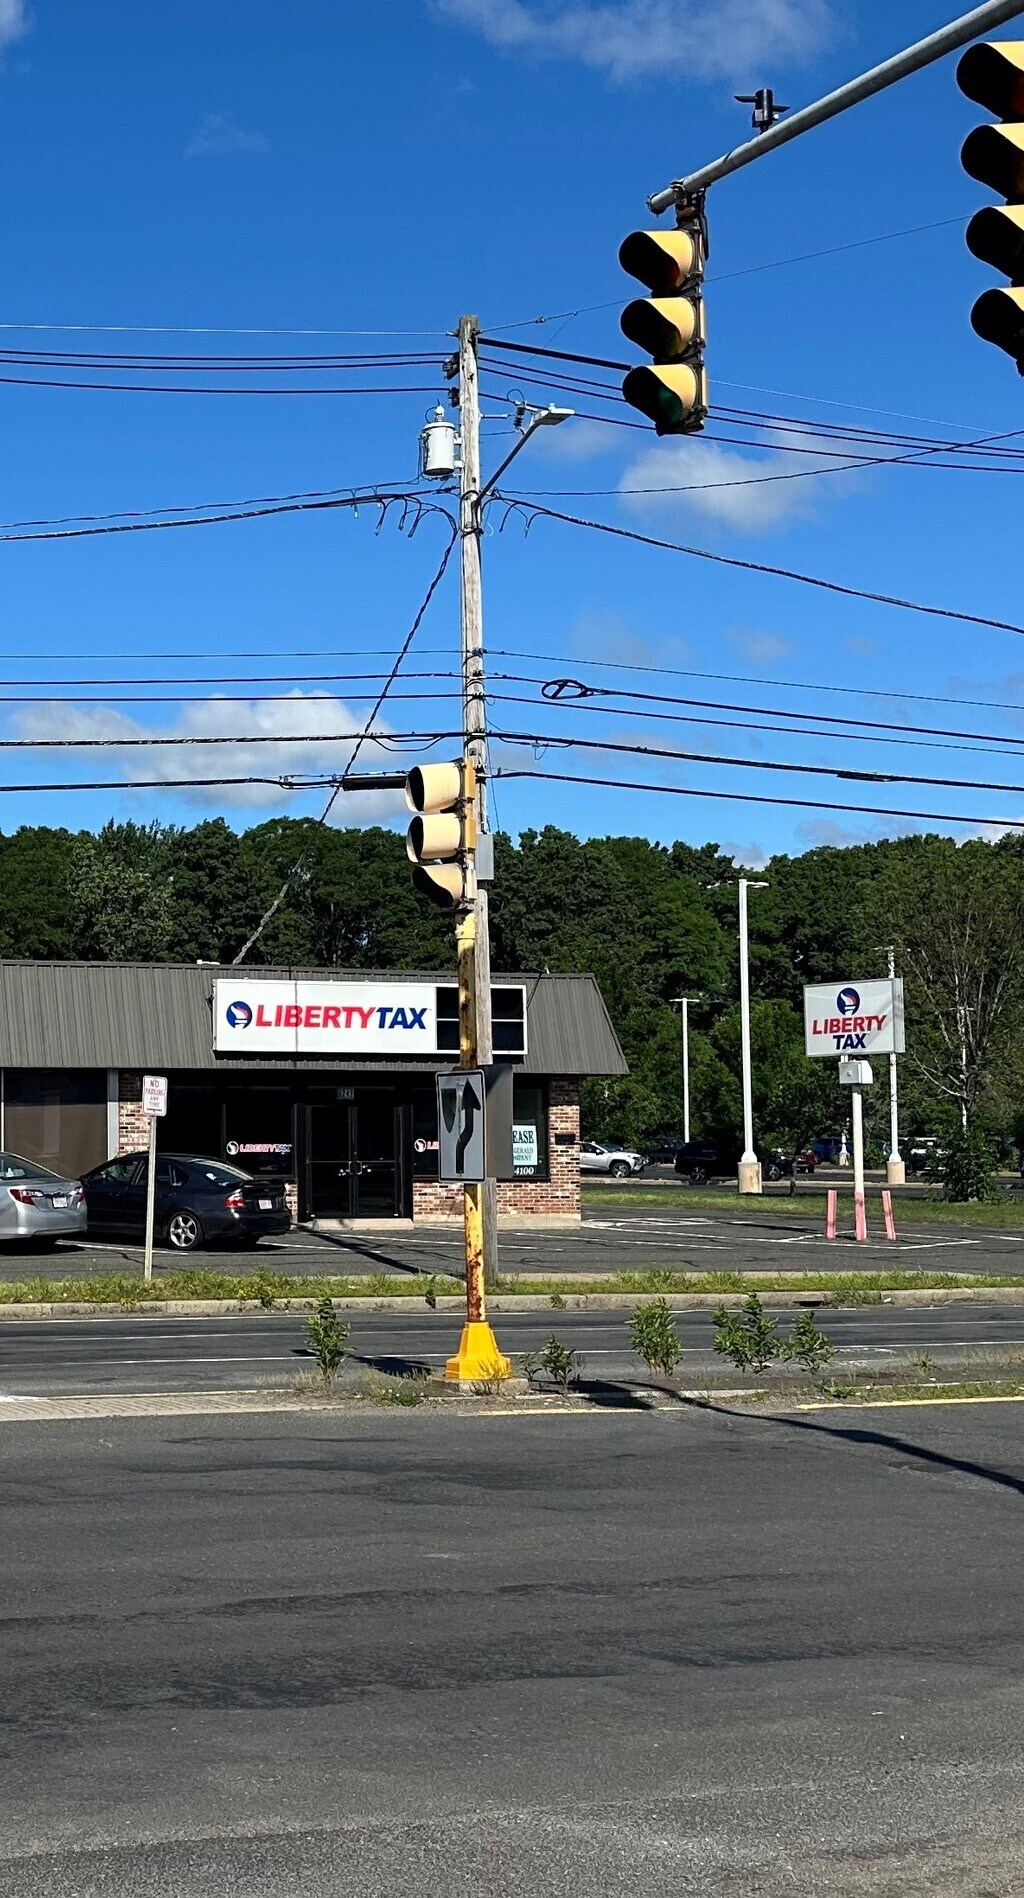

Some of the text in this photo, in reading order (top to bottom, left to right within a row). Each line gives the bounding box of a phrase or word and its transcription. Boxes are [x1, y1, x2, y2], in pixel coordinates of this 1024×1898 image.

[812, 1014, 887, 1035] LIBERTY
[833, 1033, 867, 1051] TAX
[150, 1080, 160, 1088] NO
